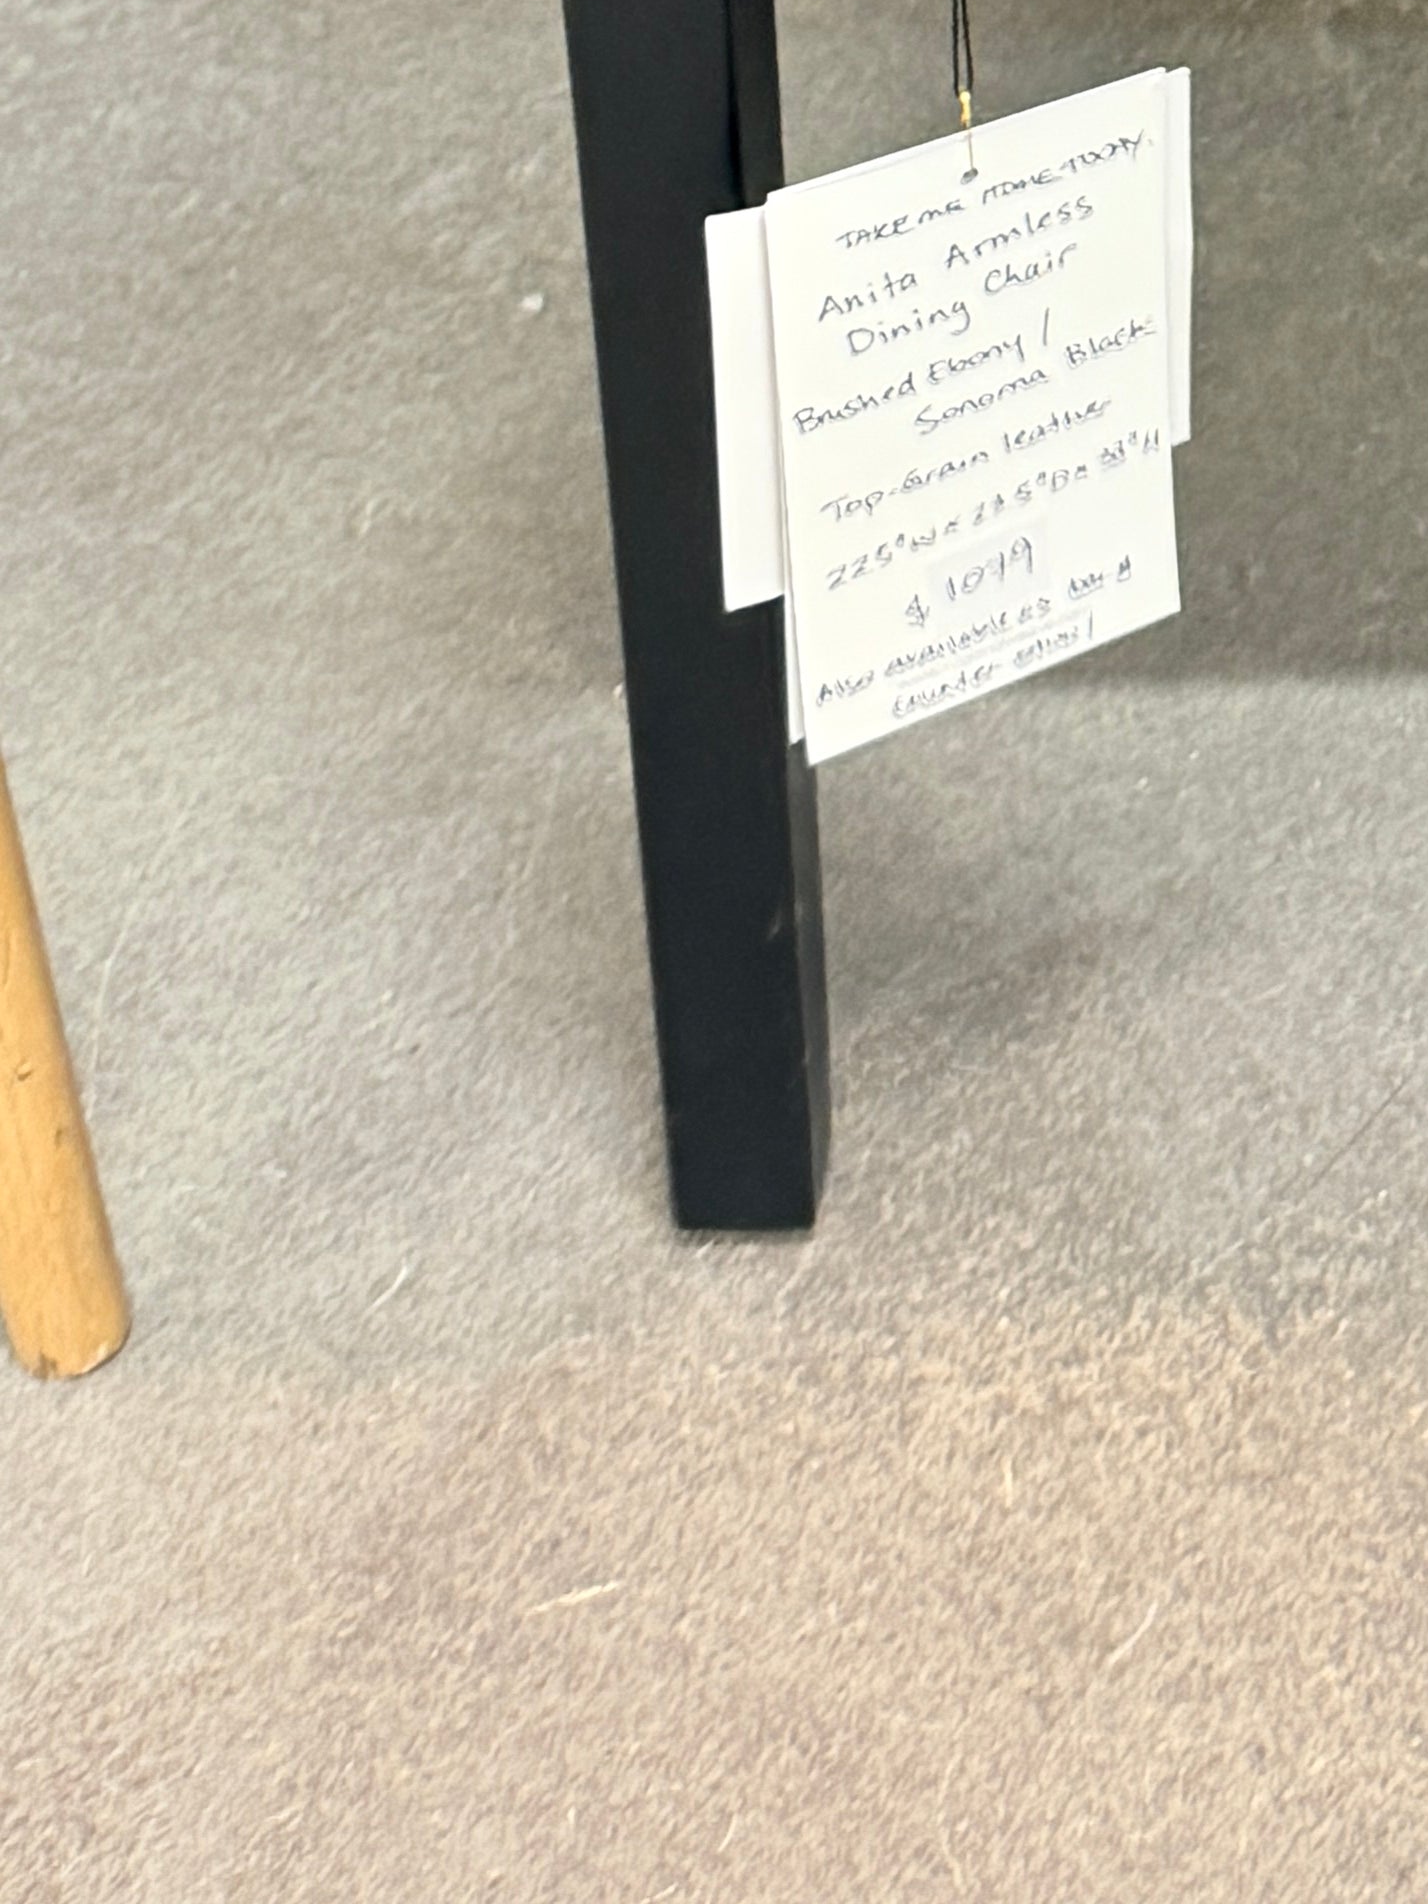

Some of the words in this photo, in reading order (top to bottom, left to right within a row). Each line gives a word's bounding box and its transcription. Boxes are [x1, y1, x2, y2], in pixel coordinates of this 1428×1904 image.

[818, 271, 918, 323] Anita
[944, 194, 1094, 269] Armless
[836, 214, 915, 249] TAKE
[917, 198, 966, 225] ME
[846, 300, 971, 357] Dining
[983, 242, 1078, 296] Chair
[793, 371, 917, 434] Brushed
[926, 333, 1026, 386] Ebony
[914, 368, 1050, 437] Sonoma
[1066, 315, 1158, 370] Black
[815, 669, 875, 707] Also
[884, 610, 1009, 678] available
